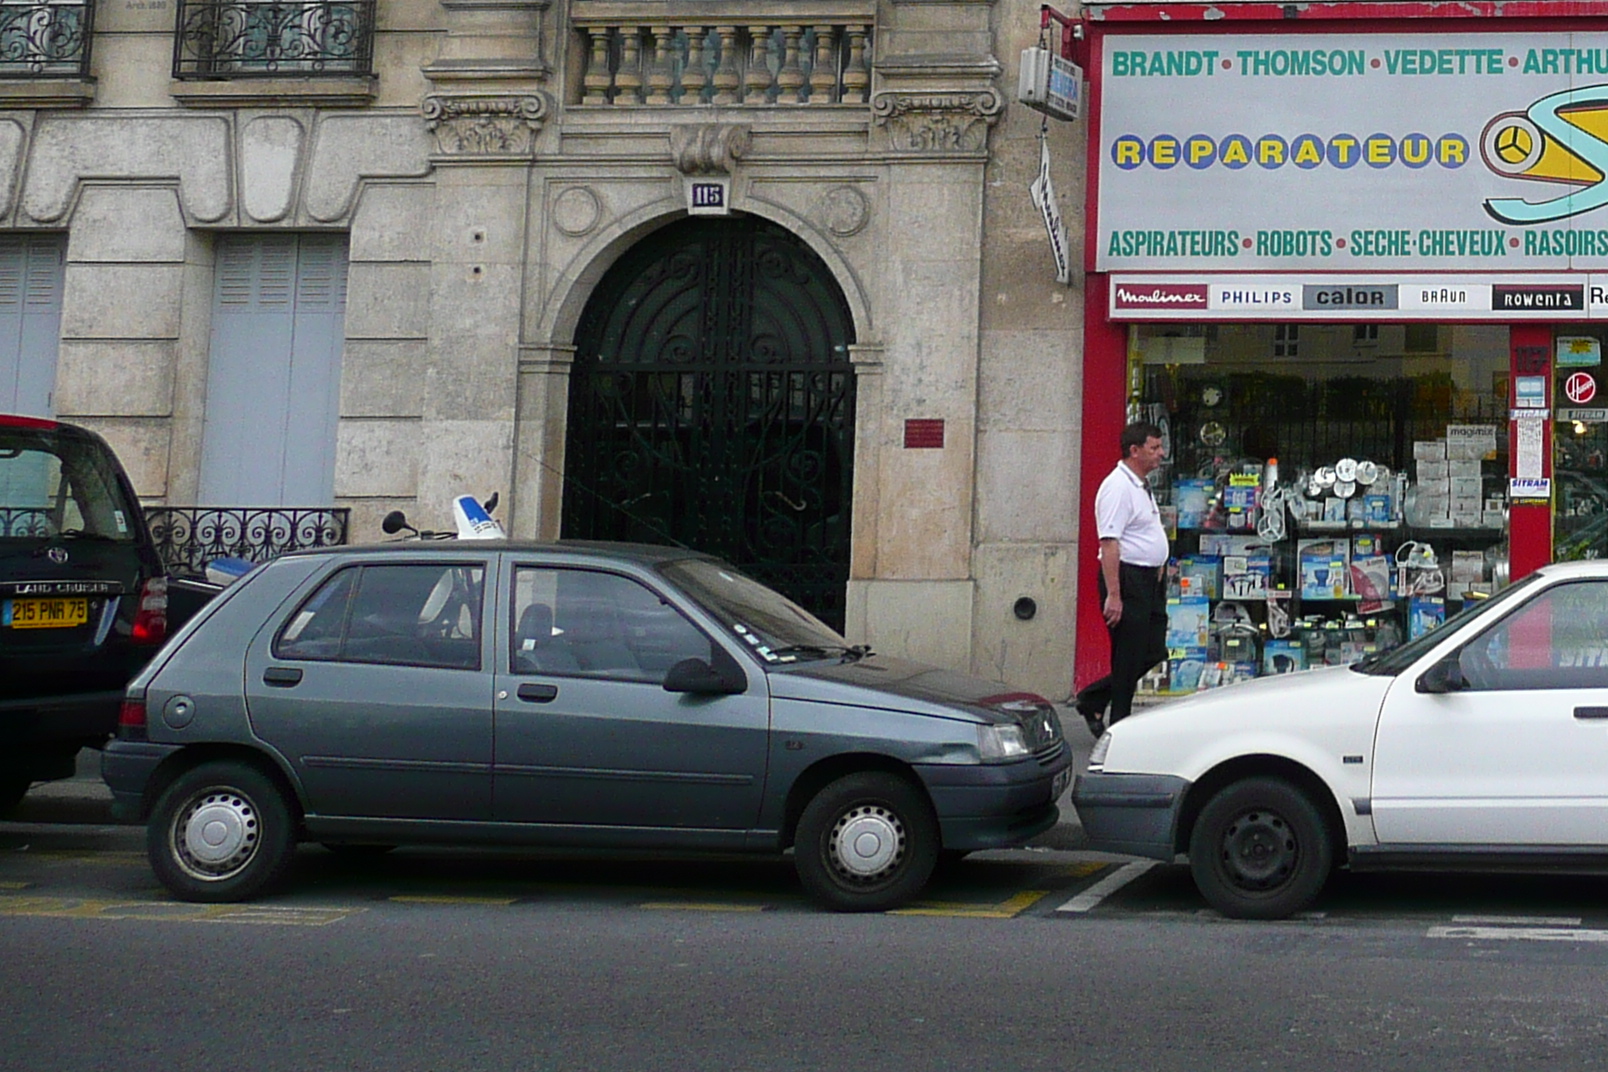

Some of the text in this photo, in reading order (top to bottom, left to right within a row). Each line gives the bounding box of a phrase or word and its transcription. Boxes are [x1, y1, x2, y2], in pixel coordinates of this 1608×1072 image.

[1112, 49, 1219, 77] BRANDT
[1237, 48, 1366, 76] THOMSON
[1384, 47, 1505, 75] VEDETTE
[1114, 136, 1469, 167] REPARATEUR
[695, 186, 720, 205] 115
[1108, 231, 1239, 257] ASPIRATEURS
[1256, 230, 1333, 257] ROBOTS
[1117, 288, 1206, 303] Moulinex
[1221, 291, 1292, 304] PHILIPS
[1421, 288, 1466, 303] BRAUN
[1511, 479, 1548, 488] SITRAM
[13, 602, 36, 621] 215
[69, 600, 85, 620] 75
